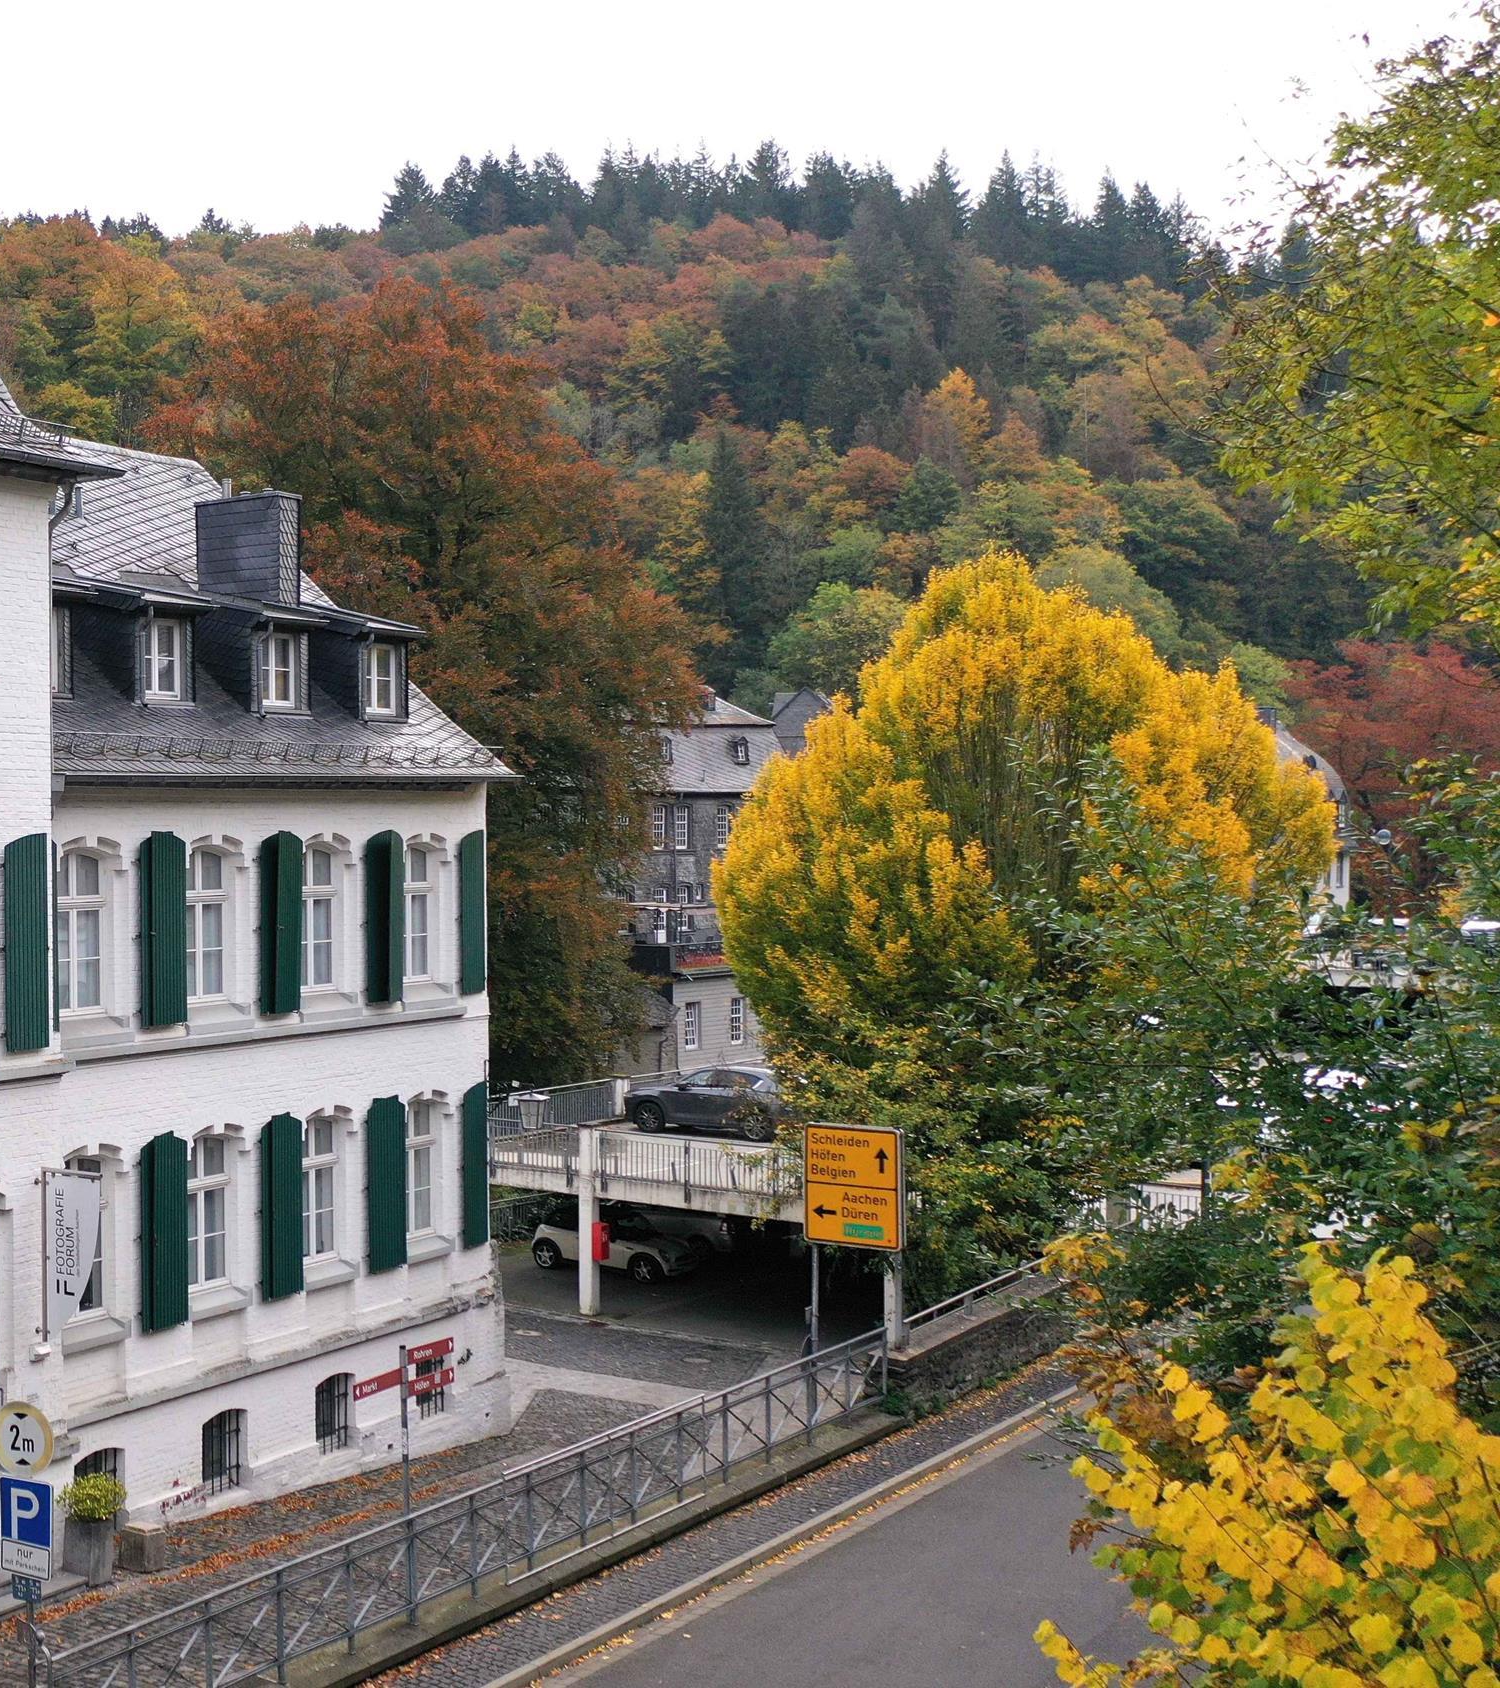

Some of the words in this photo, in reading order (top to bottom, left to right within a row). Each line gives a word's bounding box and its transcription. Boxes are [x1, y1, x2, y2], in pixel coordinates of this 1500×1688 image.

[811, 1132, 870, 1148] Schleiden
[811, 1148, 846, 1162] Höfen
[811, 1164, 856, 1180] Belgien
[842, 1192, 888, 1206] Aachen
[841, 1206, 879, 1221] Düren
[55, 1187, 65, 1275] FOTOGRAFIE
[65, 1227, 75, 1276] FORUM
[362, 1381, 378, 1395] Markt
[10, 1487, 40, 1540] P
[17, 1548, 33, 1560] nur
[4, 1558, 14, 1566] mit
[15, 1559, 47, 1574] Parkschein
